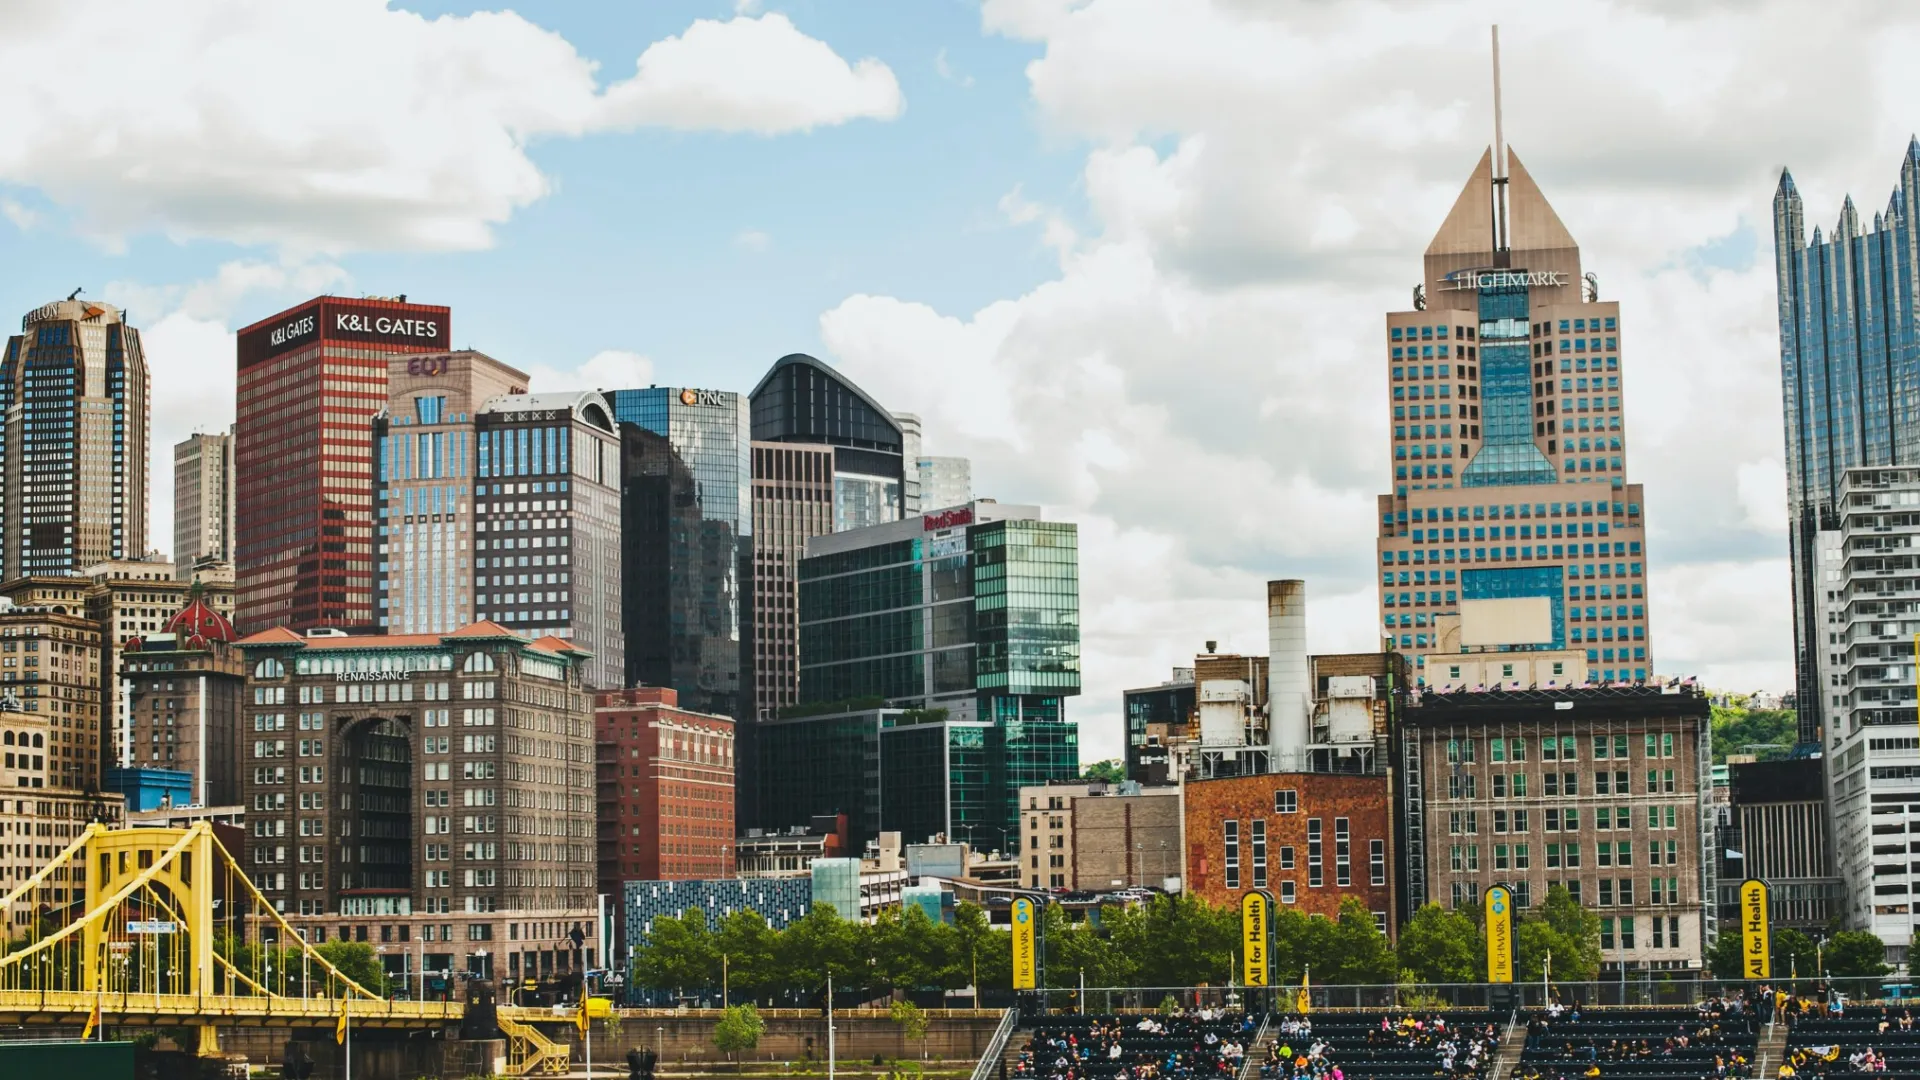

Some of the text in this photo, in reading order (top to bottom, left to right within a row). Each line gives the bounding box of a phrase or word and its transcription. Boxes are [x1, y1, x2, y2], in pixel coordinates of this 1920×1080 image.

[1457, 270, 1560, 289] HIGHMARK
[271, 315, 314, 346] K&L GATES
[337, 313, 437, 338] K&L GATES
[407, 356, 451, 376] EQT
[697, 392, 726, 406] PNC
[336, 671, 410, 681] RENAISSANCE
[1248, 900, 1262, 985] All for Health
[1747, 887, 1764, 977] All for Health
[1020, 928, 1030, 982] HIGHMARK
[1496, 920, 1507, 976] HIGHMARK
